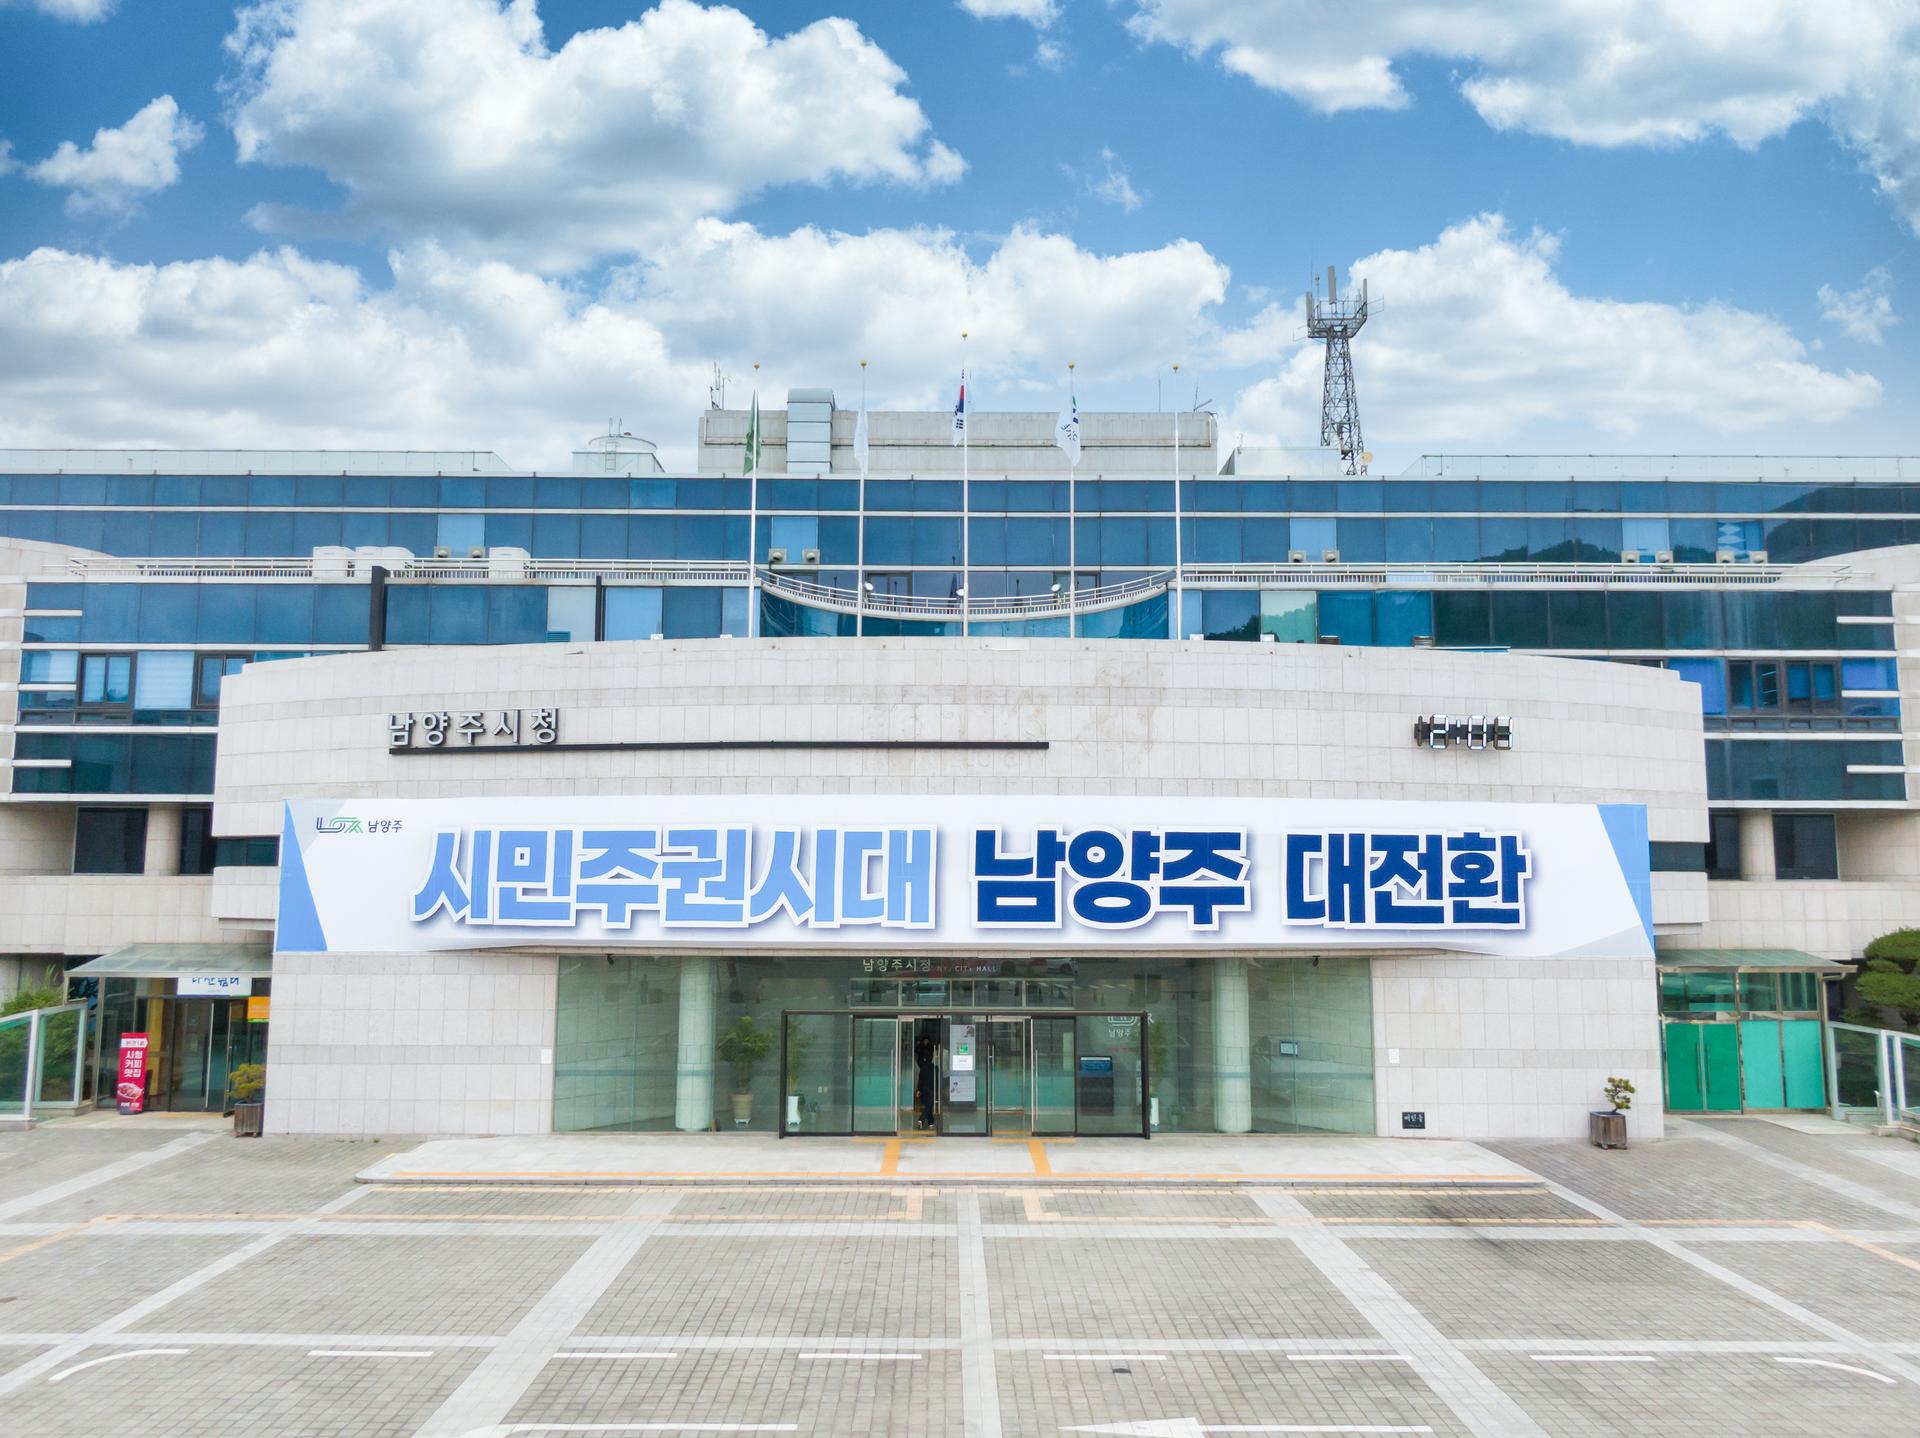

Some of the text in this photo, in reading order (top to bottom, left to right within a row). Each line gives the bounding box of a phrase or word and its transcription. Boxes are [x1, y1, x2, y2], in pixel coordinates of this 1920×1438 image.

[389, 707, 559, 748] 남양주시청
[367, 819, 403, 834] 남양주
[411, 825, 1529, 928] 시민주권시대 남양주 대전환
[124, 1059, 142, 1069] 커피
[123, 1068, 141, 1078] 맛집
